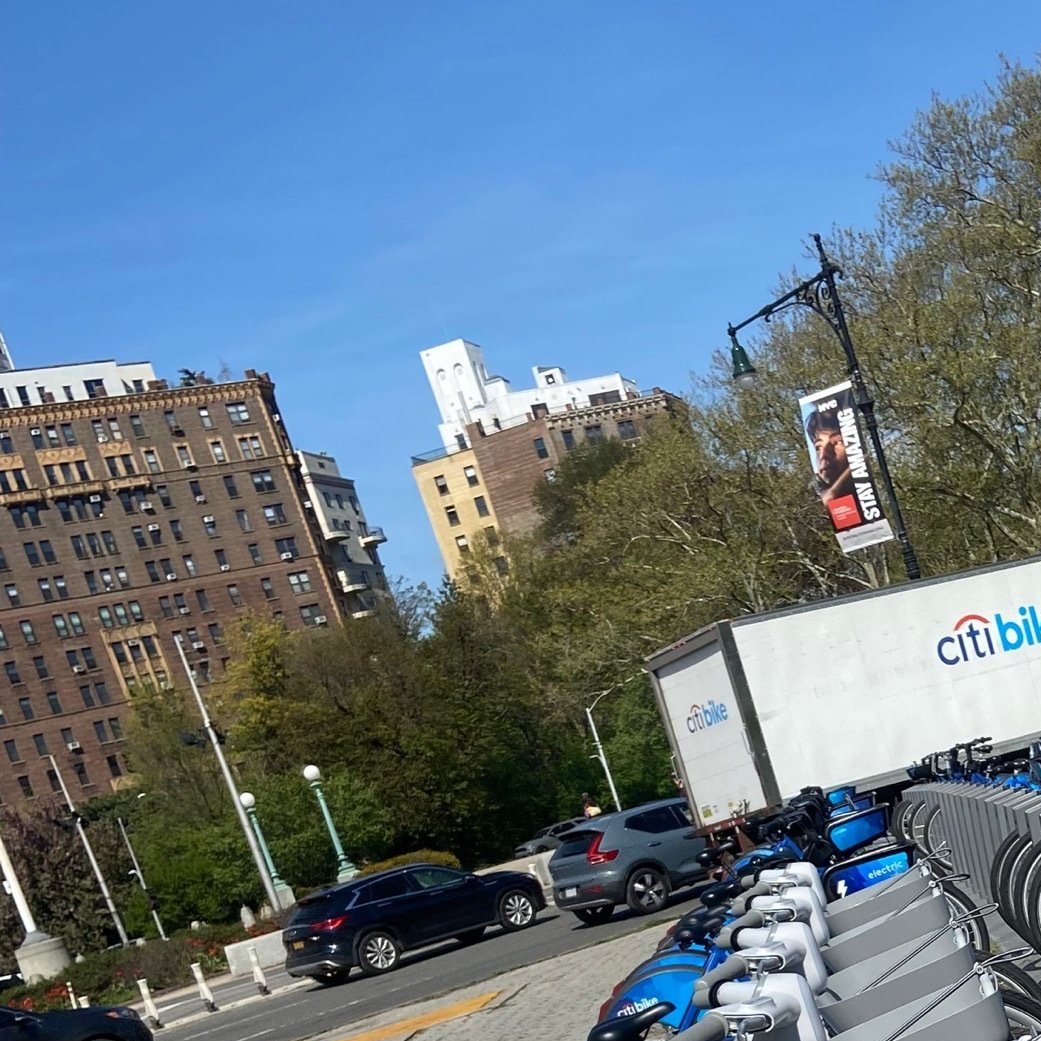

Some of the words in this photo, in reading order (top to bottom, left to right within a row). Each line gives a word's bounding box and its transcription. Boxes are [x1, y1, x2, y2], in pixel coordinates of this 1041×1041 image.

[818, 399, 837, 413] NYC
[837, 407, 869, 478] AMAZING
[854, 482, 880, 521] STAY
[937, 614, 996, 666] citi
[686, 703, 706, 734] citi
[704, 699, 728, 726] bike
[868, 860, 903, 879] electric
[635, 996, 659, 1014] bike
